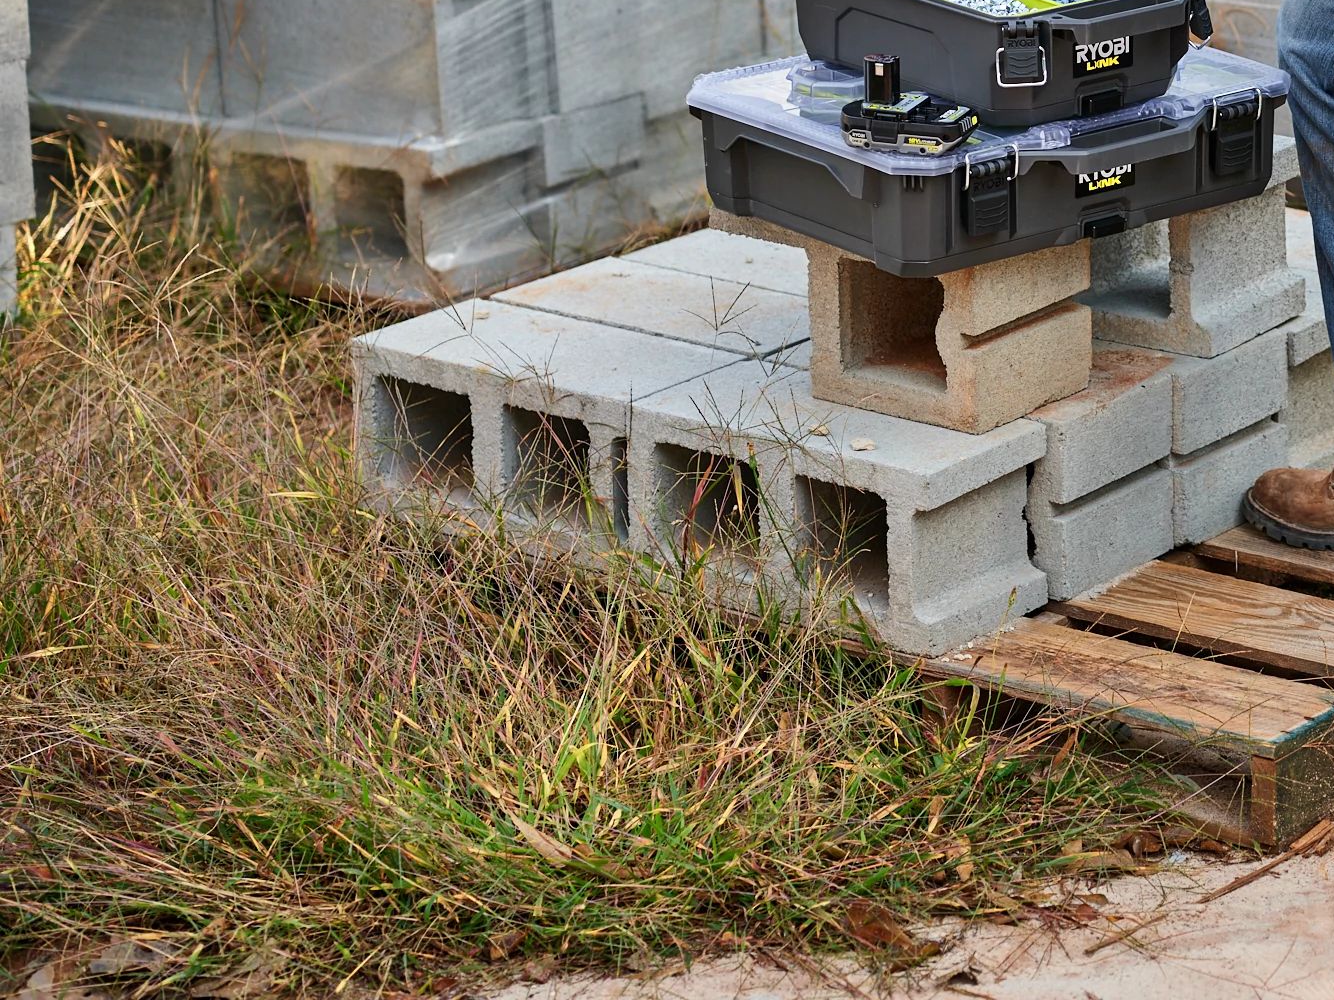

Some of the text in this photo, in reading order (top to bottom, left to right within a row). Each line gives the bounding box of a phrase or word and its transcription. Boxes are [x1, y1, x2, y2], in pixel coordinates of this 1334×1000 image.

[1007, 39, 1037, 48] RYOBI
[1075, 35, 1130, 64] RYOBI
[1086, 55, 1120, 71] LINK
[1088, 175, 1122, 191] LINK
